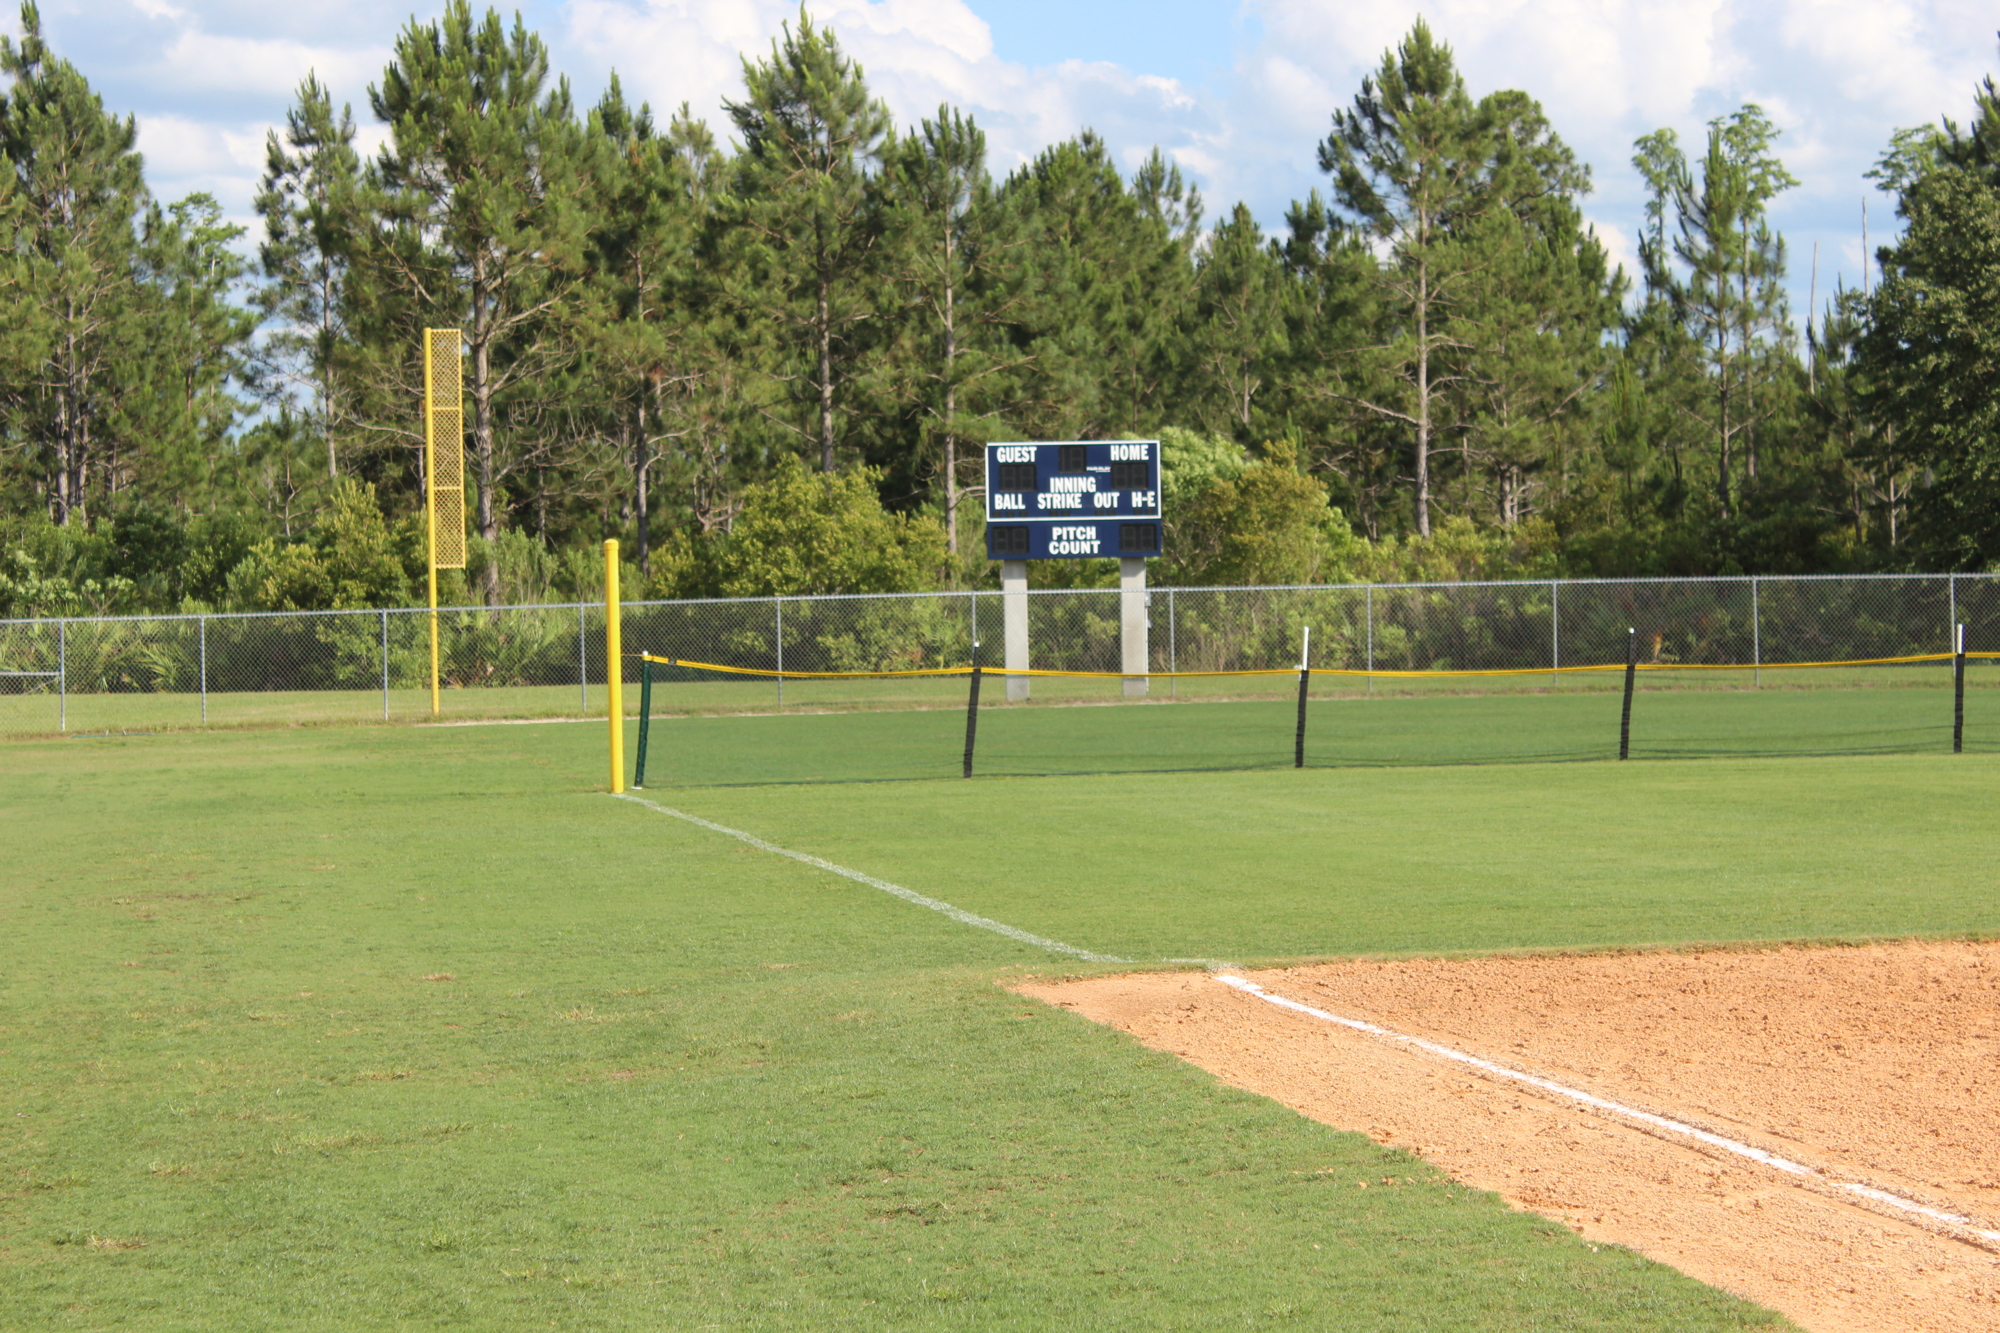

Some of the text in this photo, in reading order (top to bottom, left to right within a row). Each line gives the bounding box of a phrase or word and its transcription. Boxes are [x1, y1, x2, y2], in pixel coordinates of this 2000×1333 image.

[997, 446, 1037, 463] GUEST
[1110, 445, 1149, 461] HOME
[1050, 477, 1096, 493] INNING
[995, 491, 1156, 510] BALL STRIKE OUT H-E
[1052, 526, 1096, 540] PITCH
[1049, 540, 1101, 555] COUNT
